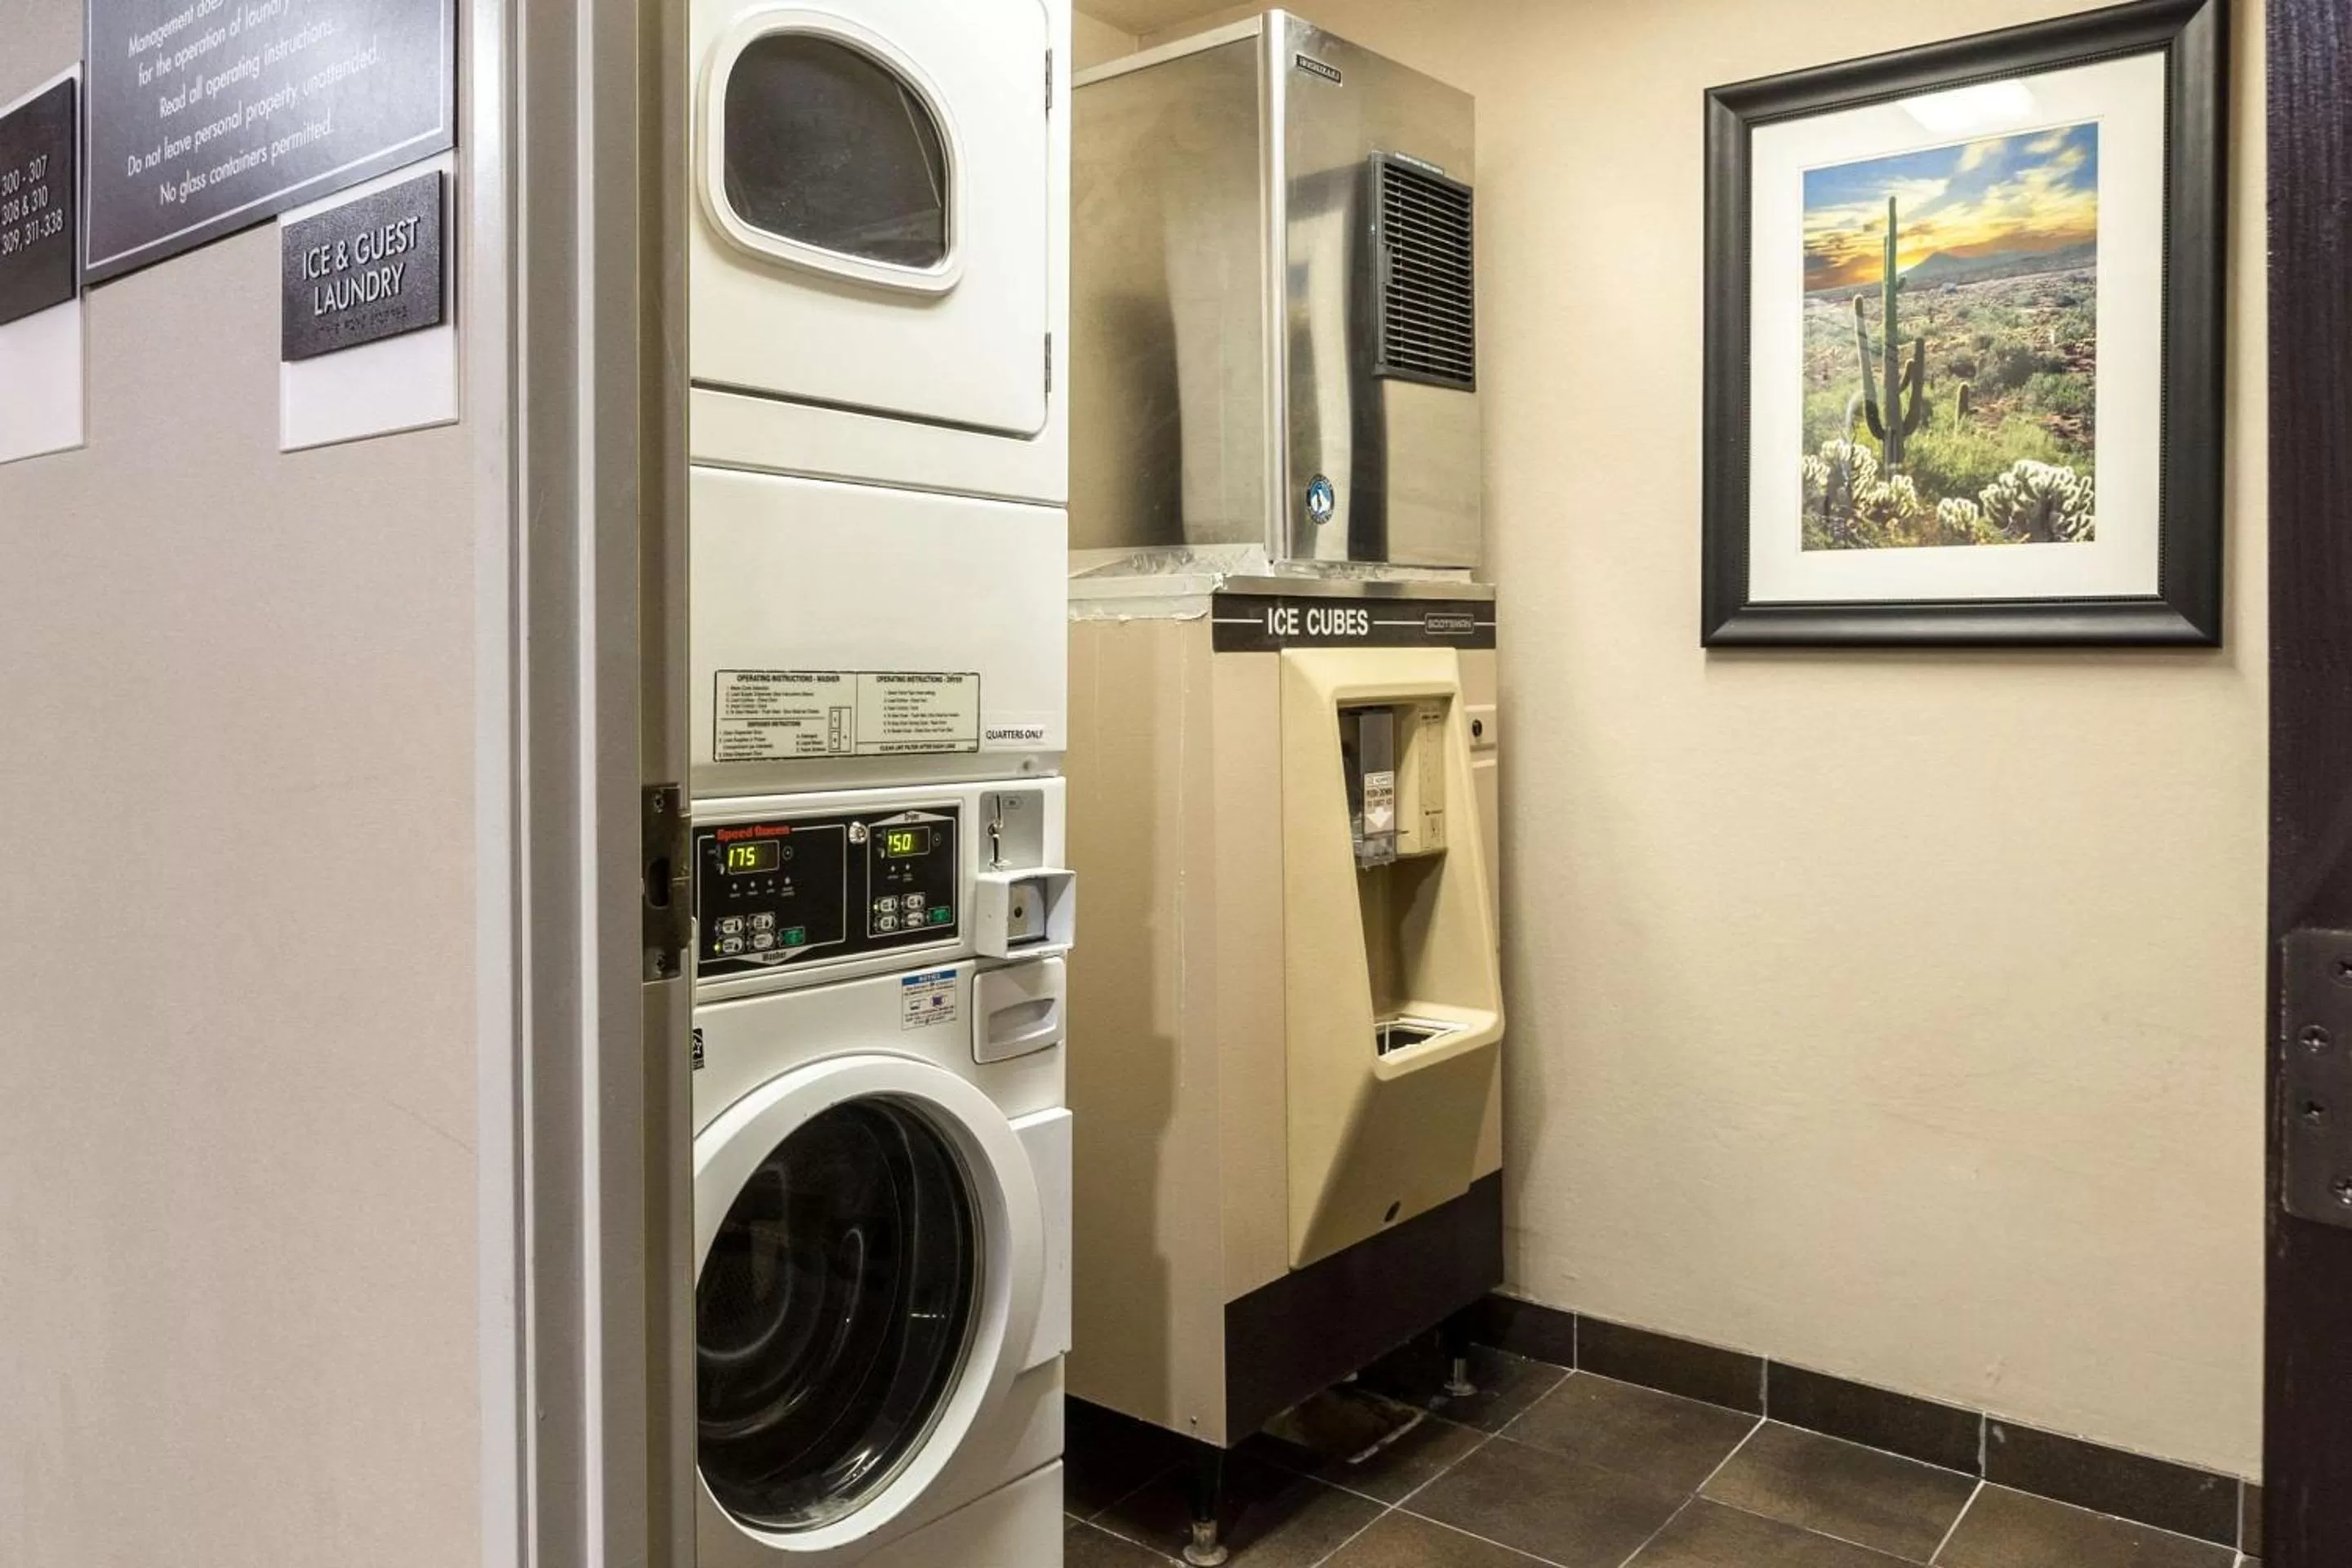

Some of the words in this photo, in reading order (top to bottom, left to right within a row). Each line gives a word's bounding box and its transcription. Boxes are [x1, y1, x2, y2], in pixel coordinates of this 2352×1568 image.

[128, 4, 194, 59] Management
[139, 62, 154, 87] for
[156, 52, 172, 77] the
[175, 27, 225, 72] operation
[229, 7, 242, 37] of
[160, 82, 185, 118] Read
[189, 74, 203, 105] all
[206, 55, 260, 99] operating
[127, 155, 142, 177] Do
[145, 145, 161, 170] not
[163, 136, 192, 163] leave
[194, 100, 243, 154] personal
[2, 169, 20, 196] 300
[29, 154, 47, 183] 307
[159, 181, 176, 205] No
[179, 170, 207, 203] glass
[209, 147, 267, 185] containers
[2, 199, 20, 225] 308
[22, 194, 29, 216] &
[32, 185, 48, 212] 310
[303, 245, 331, 281] ICE
[336, 240, 350, 271] &
[355, 216, 420, 265] GUEST
[314, 262, 405, 316] LAUNDRY
[1267, 608, 1299, 635] ICE
[1307, 608, 1368, 635] CUBES
[986, 729, 1024, 740] QUARTERS
[717, 828, 753, 841] Speed
[754, 826, 790, 836] Queen
[728, 847, 755, 867] 175
